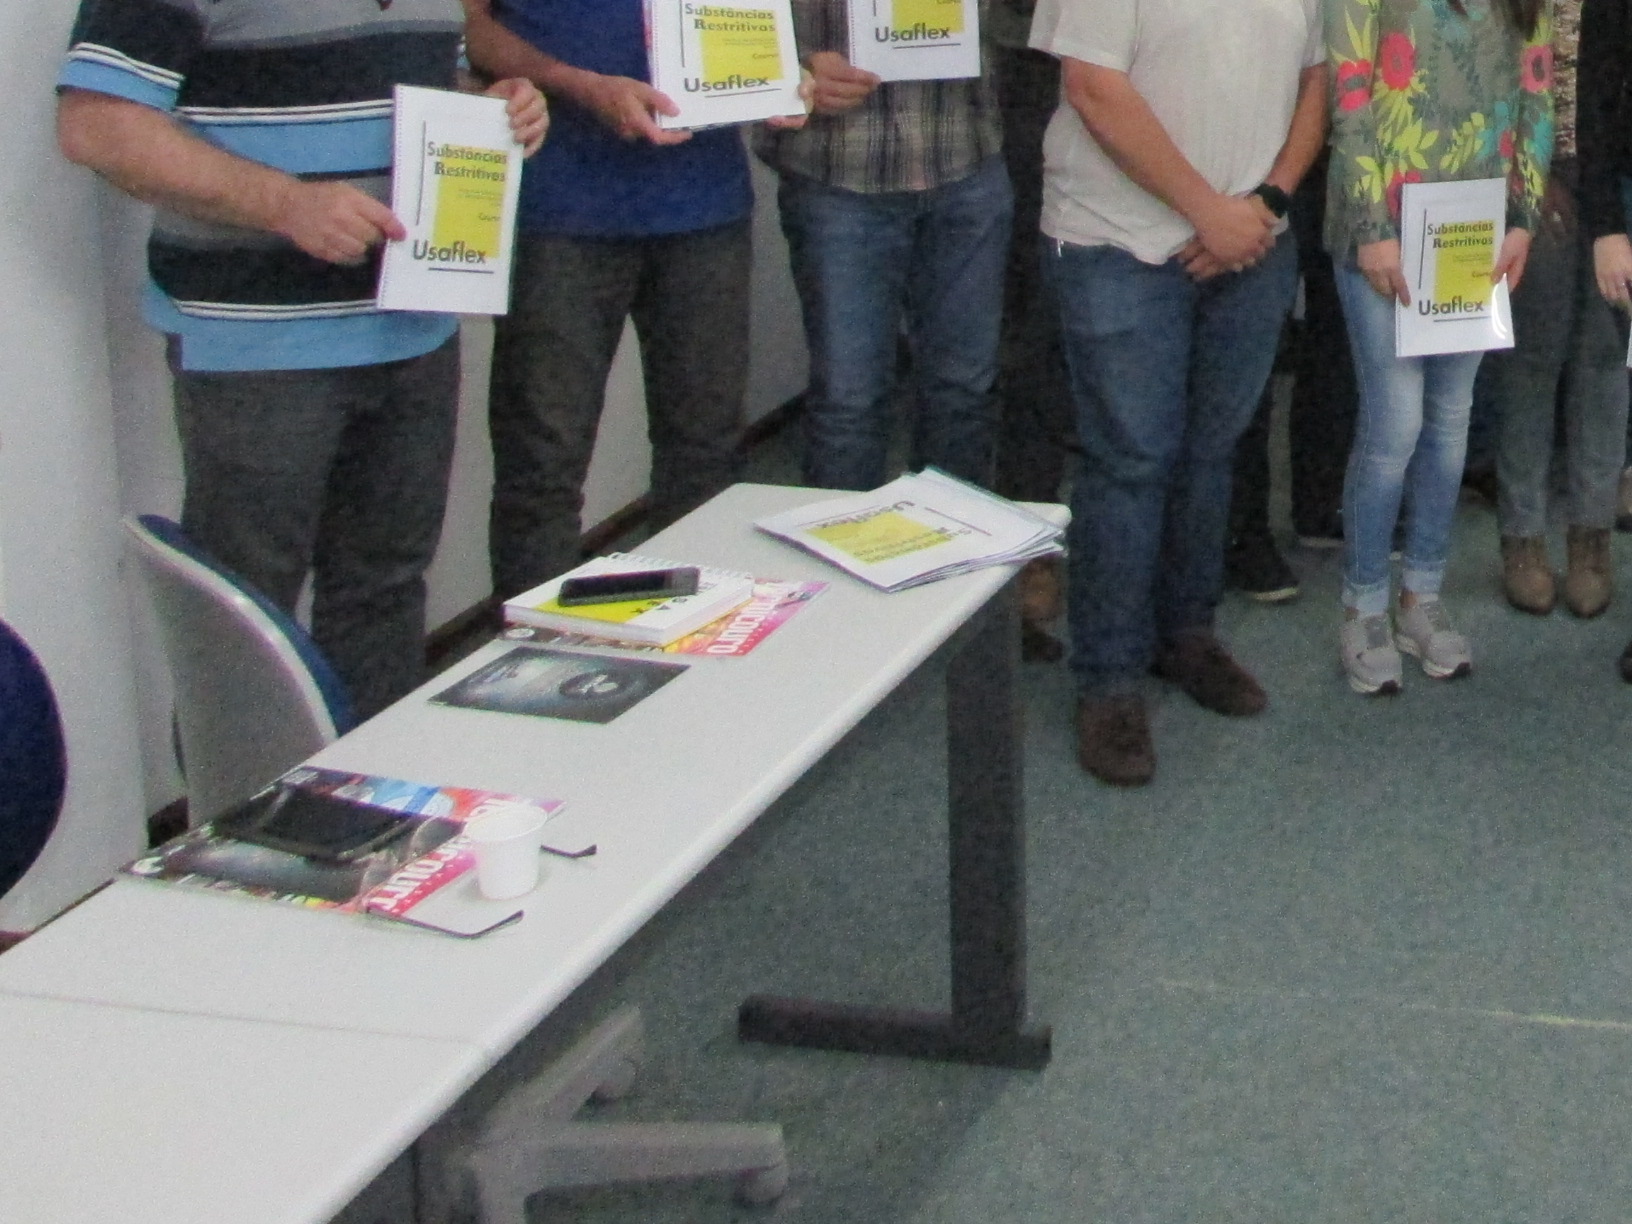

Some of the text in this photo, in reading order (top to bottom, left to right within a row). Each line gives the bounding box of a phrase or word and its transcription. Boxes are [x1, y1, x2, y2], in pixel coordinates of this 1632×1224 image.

[685, 5, 774, 20] Substâncias
[694, 18, 776, 32] Restritivas
[875, 22, 950, 43] Usaflex
[684, 74, 770, 93] Usaflex
[434, 160, 506, 182] Restritivas
[1427, 221, 1494, 236] Substâncias
[413, 239, 486, 264] Usaflex
[1432, 235, 1493, 249] Restritivas
[1418, 296, 1484, 316] Usaflex
